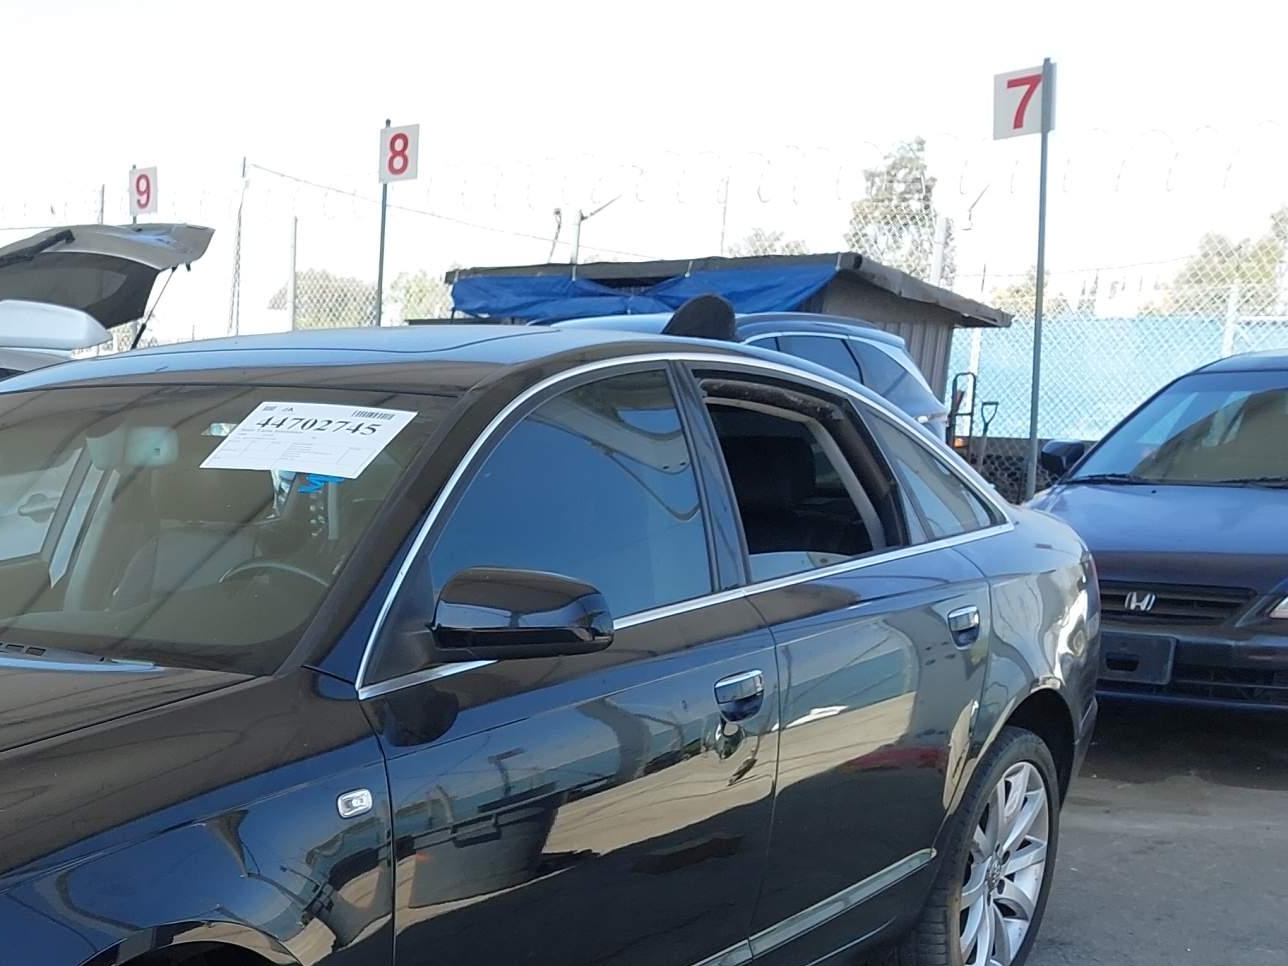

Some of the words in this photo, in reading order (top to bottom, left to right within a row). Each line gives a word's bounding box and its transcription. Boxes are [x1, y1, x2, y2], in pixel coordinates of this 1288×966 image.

[1007, 74, 1042, 129] 7
[388, 133, 409, 175] 8
[136, 174, 150, 209] 9
[256, 416, 382, 435] 44702745
